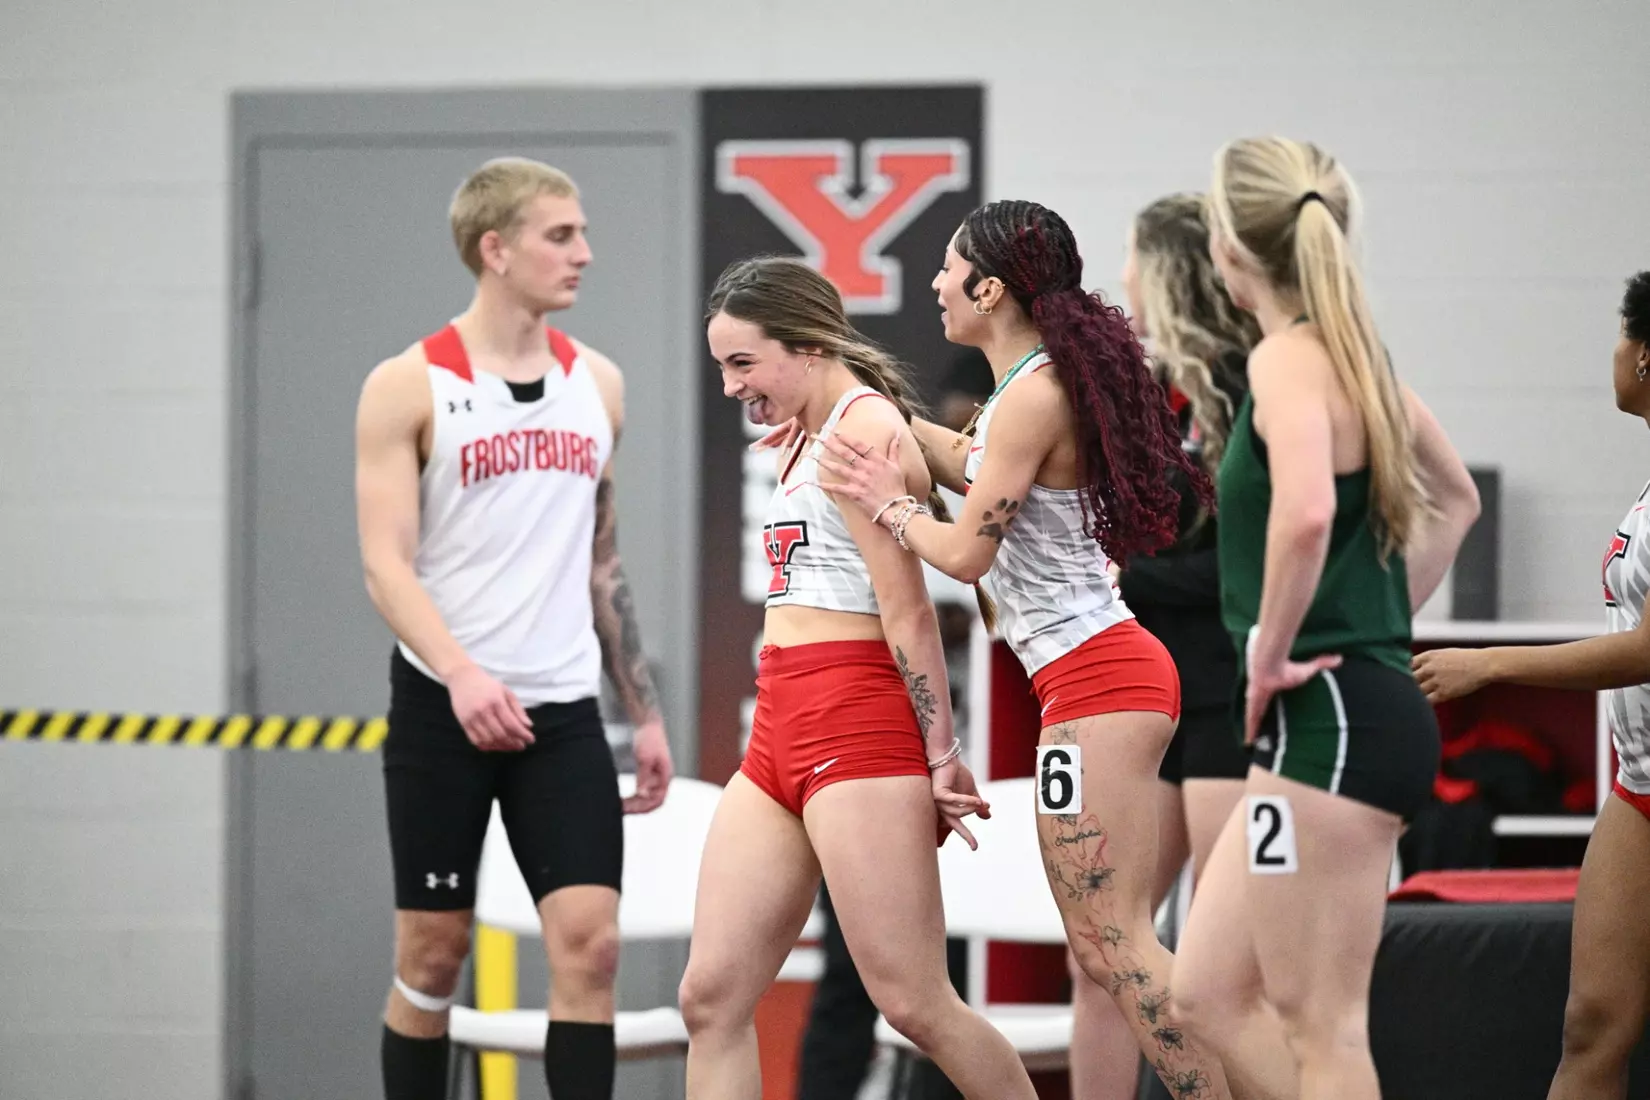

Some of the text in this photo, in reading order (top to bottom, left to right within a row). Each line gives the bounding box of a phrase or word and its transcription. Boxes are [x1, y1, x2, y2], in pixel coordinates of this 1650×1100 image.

[715, 138, 970, 314] Y
[459, 428, 599, 488] FROSTBURG
[762, 520, 809, 599] Y
[1041, 749, 1073, 810] 6
[1253, 802, 1286, 865] 2
